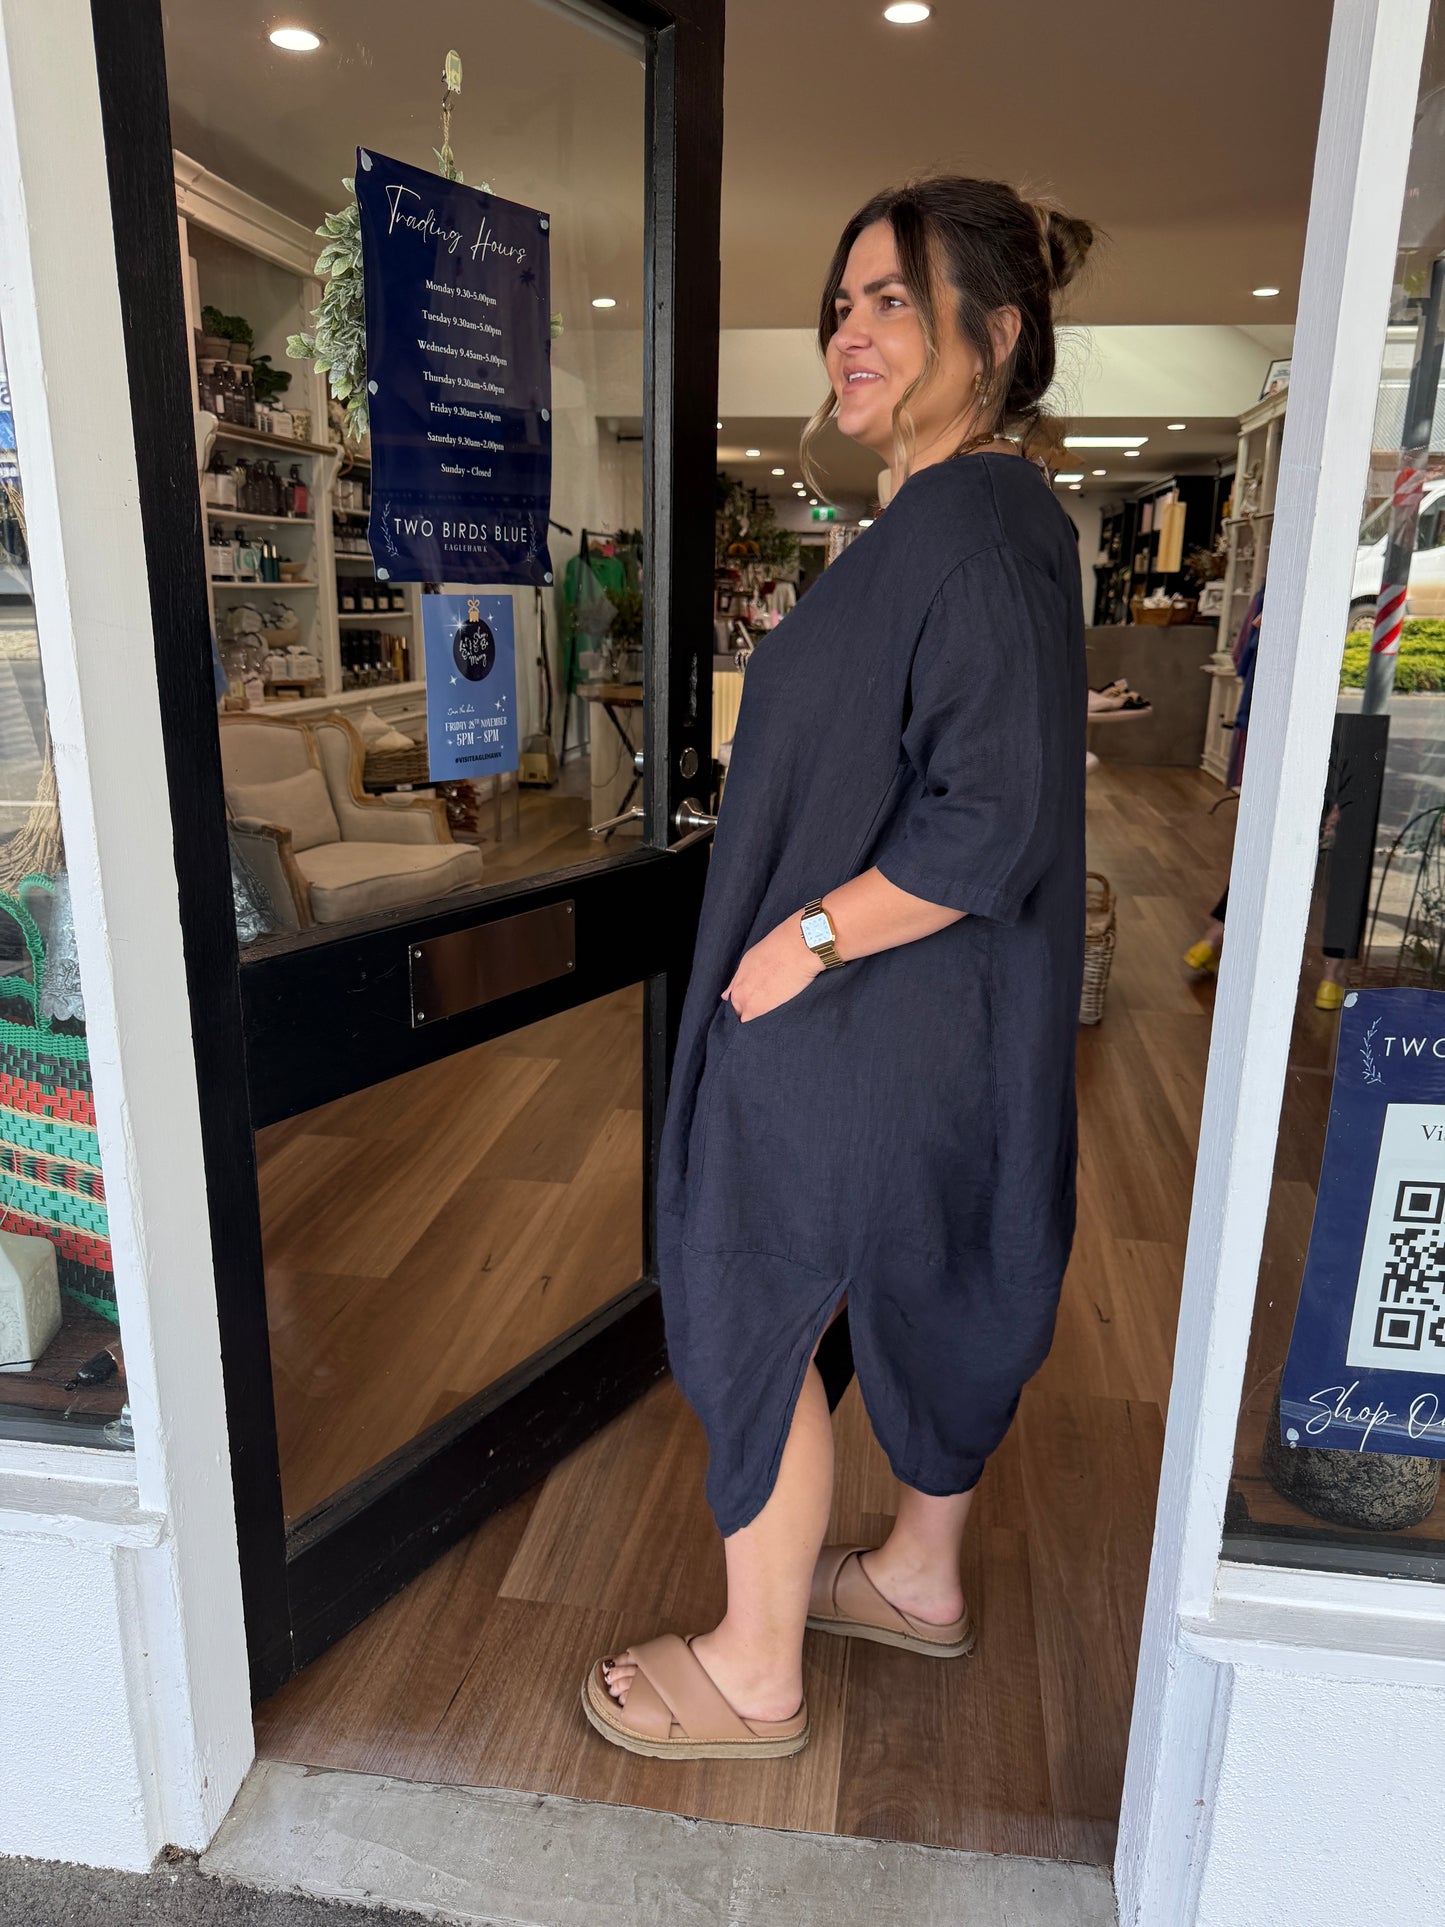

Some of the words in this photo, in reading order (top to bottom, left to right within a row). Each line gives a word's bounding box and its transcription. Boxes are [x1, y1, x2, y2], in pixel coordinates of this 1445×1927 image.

[386, 185, 463, 254] Trading
[470, 216, 527, 264] Hours
[425, 279, 455, 298] Monday
[456, 288, 497, 306] 9.30-5.00pm
[421, 309, 452, 328] Tuesday
[452, 316, 502, 337] 9.30am-5.00pm
[417, 339, 459, 359] Wednesday
[459, 348, 508, 367] 9.45am-5.00pm
[422, 370, 456, 388] Thursday
[457, 377, 505, 396] 9.30am-5.00pm
[430, 402, 453, 417] Friday
[453, 407, 502, 423] 9.30am-5.00pm
[427, 431, 457, 447] Saturday
[457, 436, 505, 453] 9.30am-2.00pm
[440, 463, 466, 477] Sunday
[471, 466, 492, 478] Closed
[393, 518, 434, 537] TWO
[442, 521, 487, 541] BIRDS
[494, 526, 528, 543] BLUE
[444, 543, 488, 553] EAGLEHAWK
[445, 721, 467, 732] FRIDAY
[480, 716, 508, 728] NOVEMBER
[456, 732, 475, 747] 5PM
[1421, 1124, 1445, 1141] Vi
[1305, 1380, 1397, 1452] Shop
